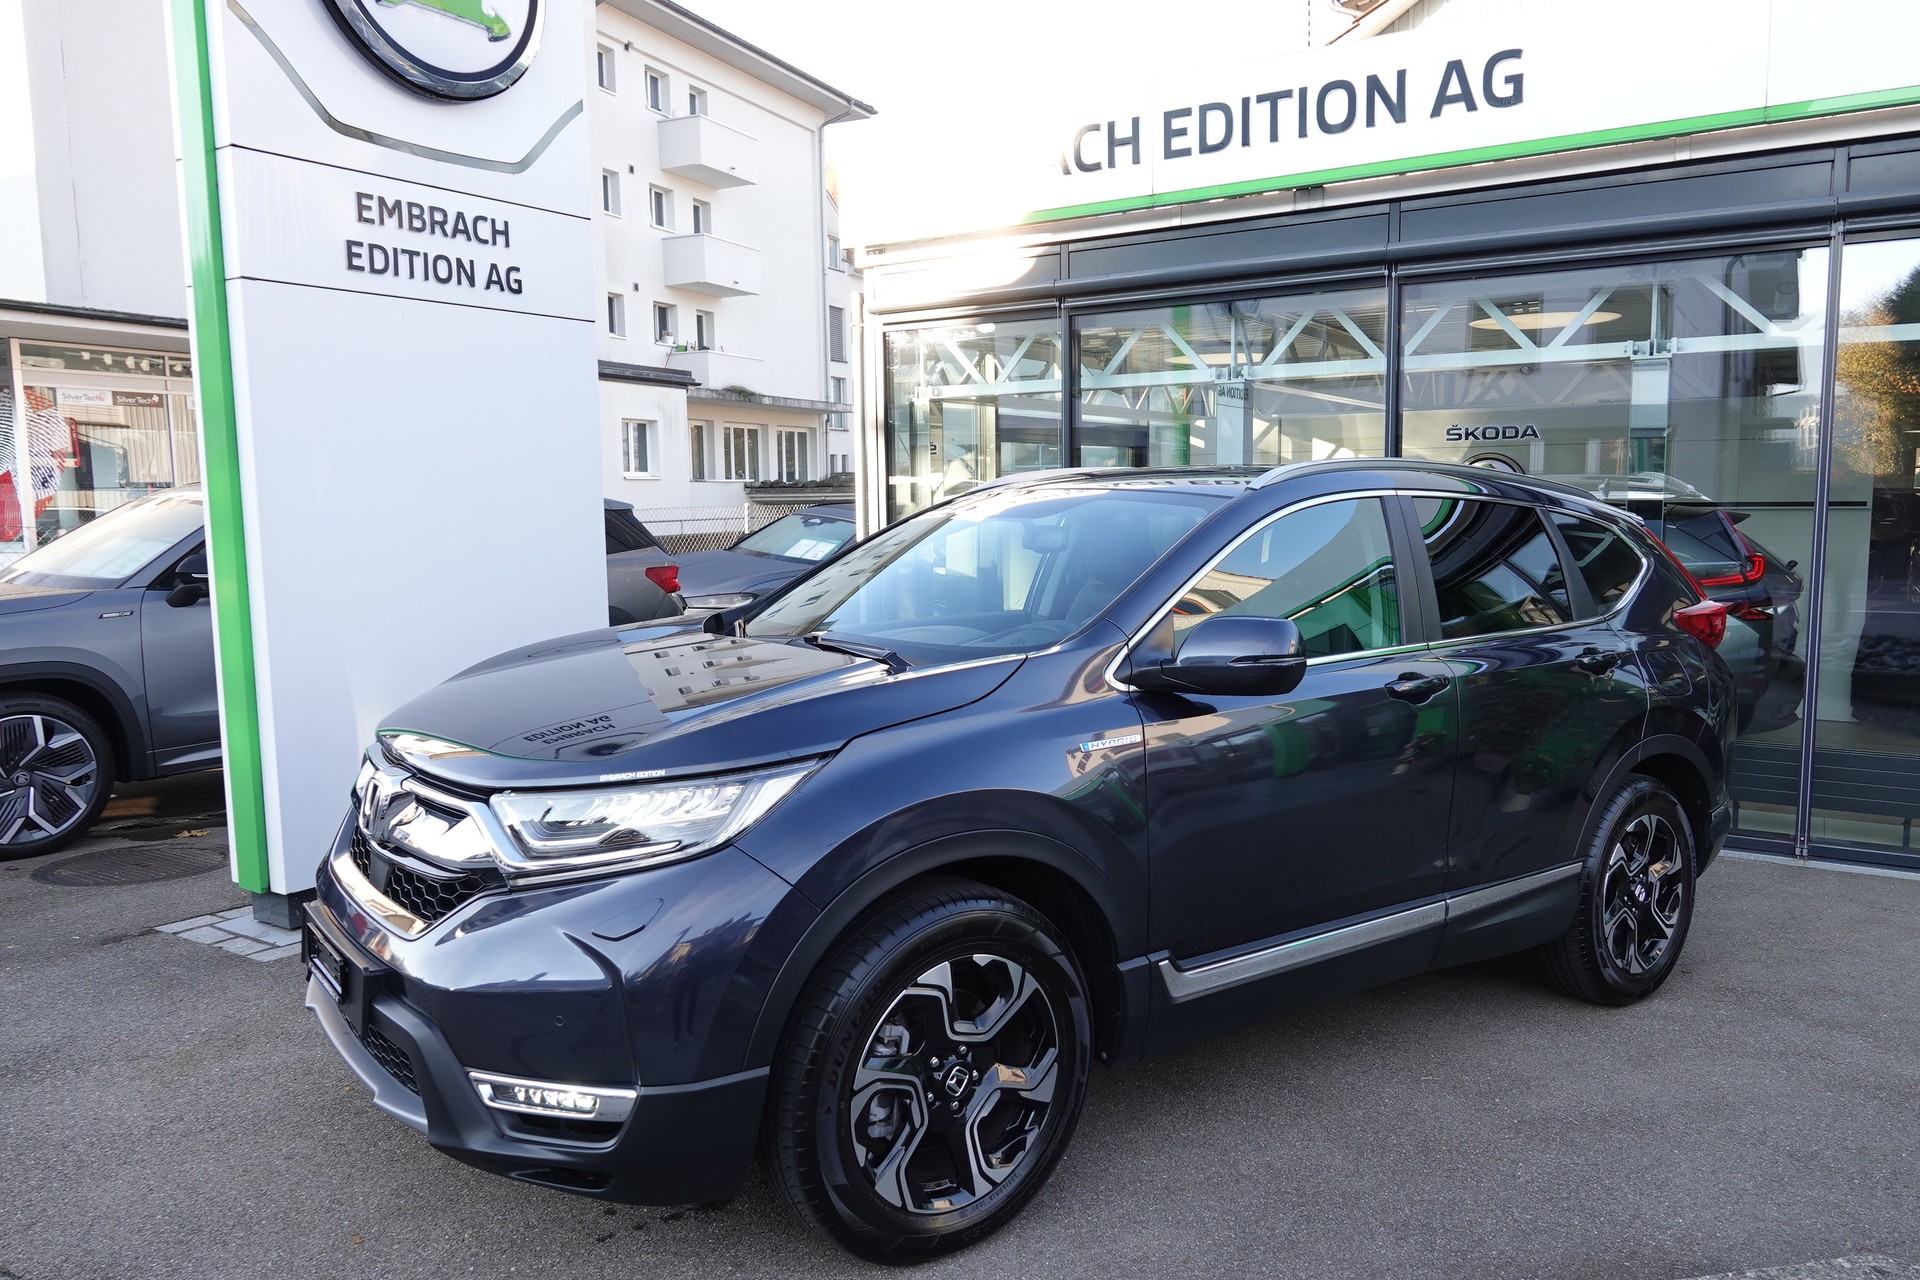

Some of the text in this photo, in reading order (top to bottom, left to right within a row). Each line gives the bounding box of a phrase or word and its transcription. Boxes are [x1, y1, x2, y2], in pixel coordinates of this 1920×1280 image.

[1164, 69, 1407, 160] EDITION
[1430, 48, 1524, 118] AG
[355, 192, 510, 248] EMBRACH
[345, 239, 523, 294] EDITION AG
[1446, 424, 1540, 441] ŠKODA
